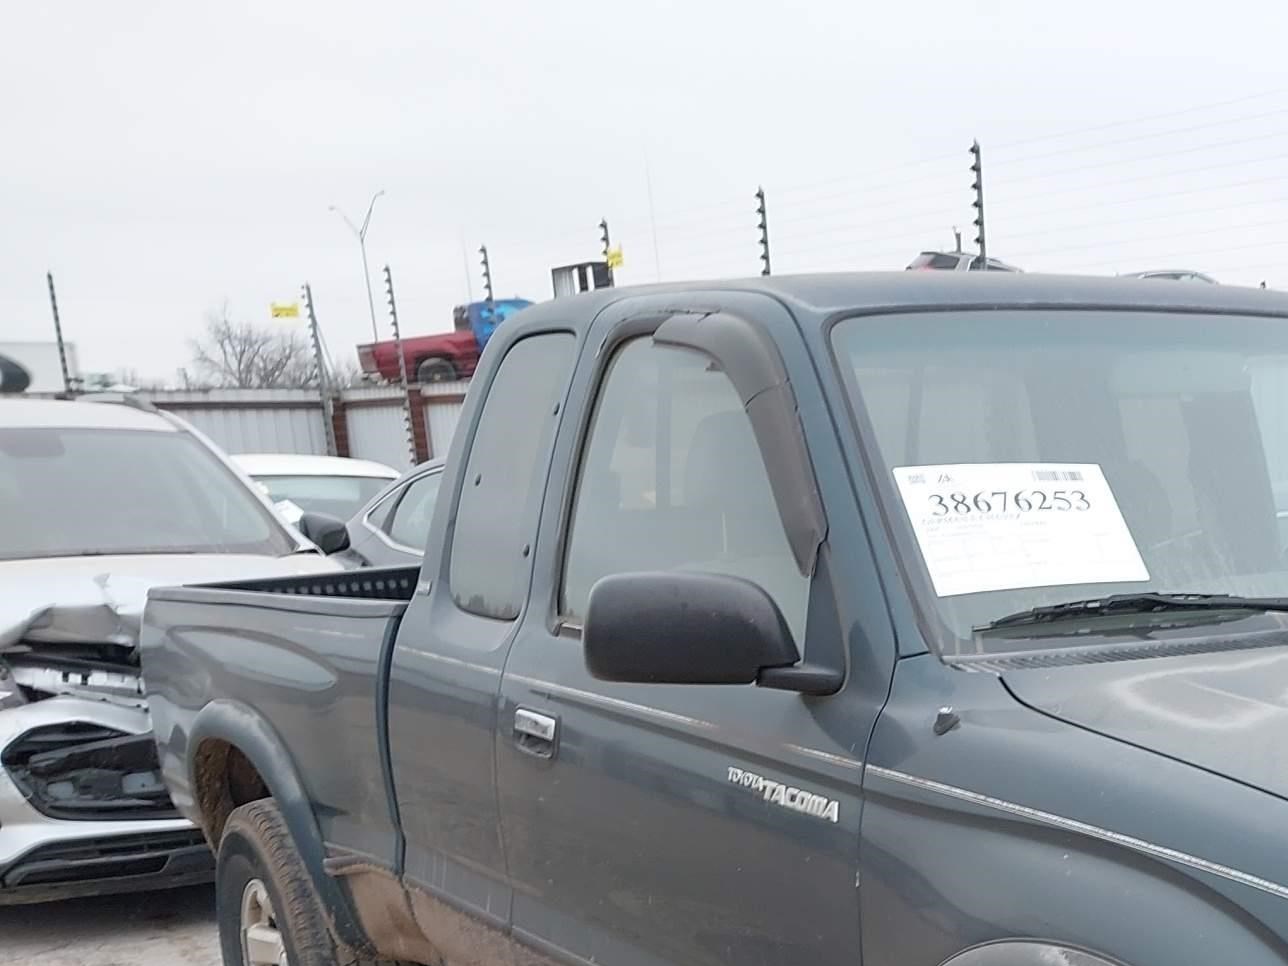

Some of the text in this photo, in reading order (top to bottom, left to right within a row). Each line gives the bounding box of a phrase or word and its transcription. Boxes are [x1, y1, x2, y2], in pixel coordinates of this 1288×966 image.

[927, 489, 1091, 517] 38676253
[727, 765, 839, 823] TOYOTA TACOMA
